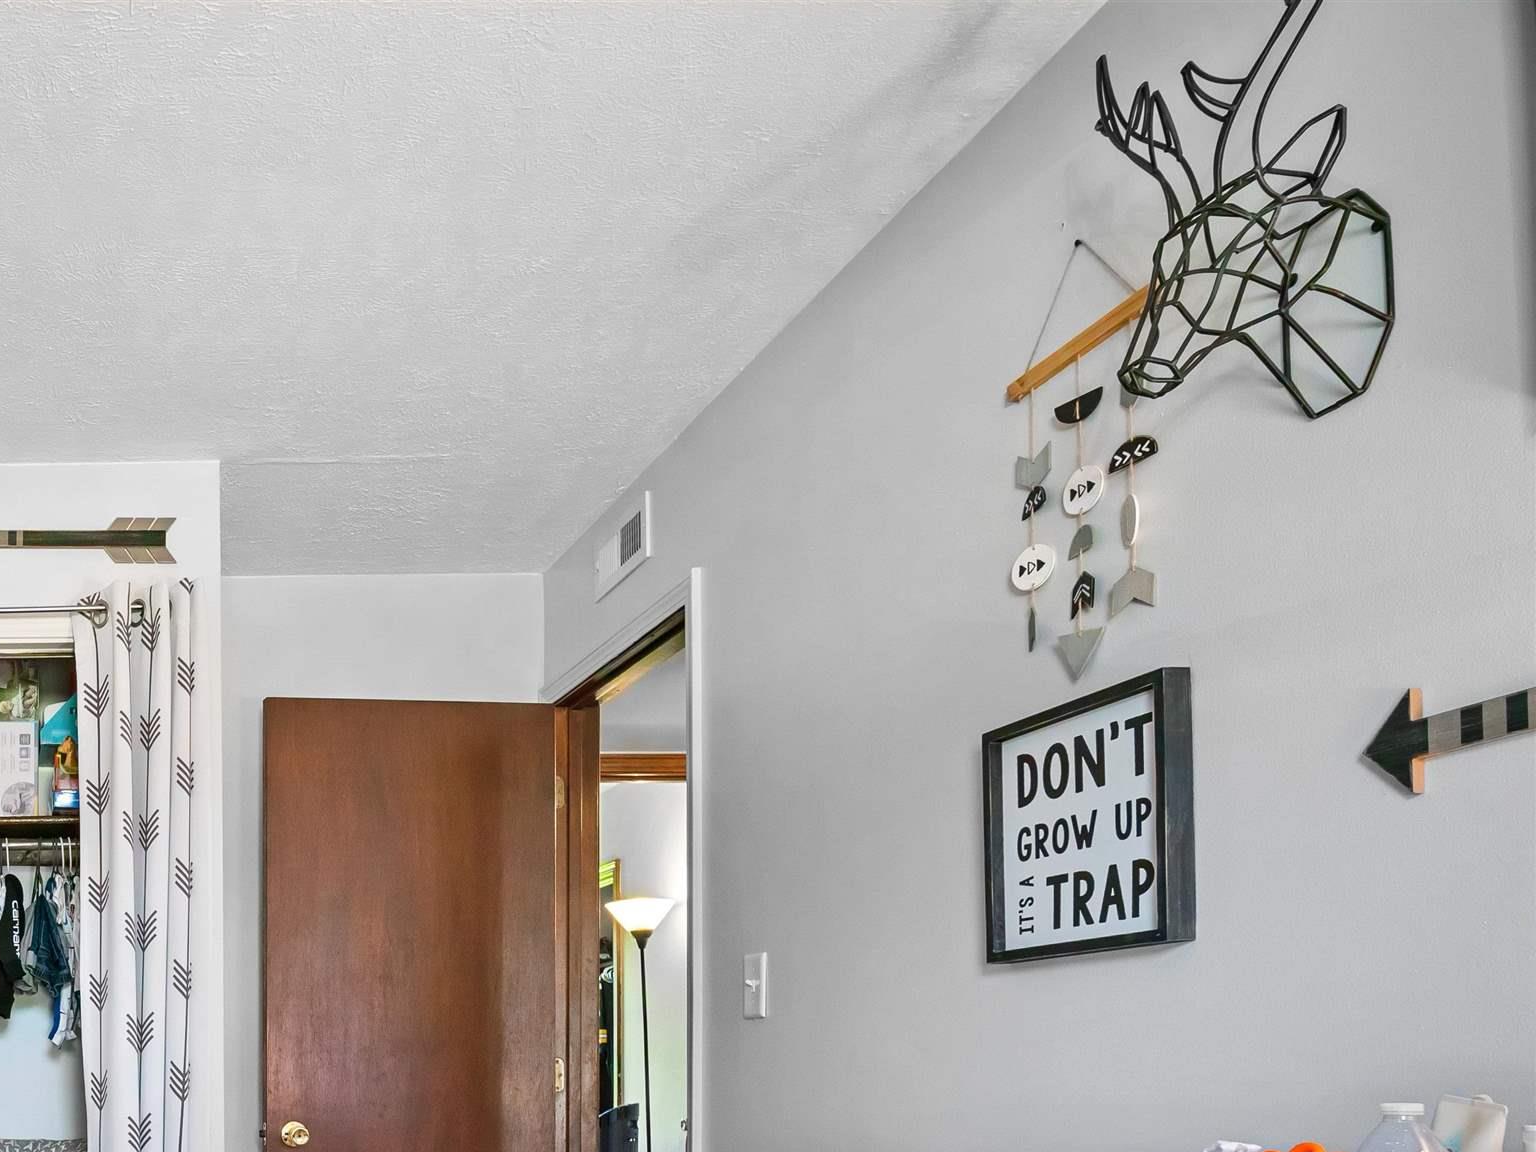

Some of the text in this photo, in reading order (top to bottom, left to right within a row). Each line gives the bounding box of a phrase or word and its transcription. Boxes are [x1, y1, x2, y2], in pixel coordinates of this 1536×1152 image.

[1017, 712, 1153, 809] DON'T
[1017, 797, 1152, 862] GROW UP
[1019, 875, 1035, 935] IT'S A
[1046, 858, 1155, 929] TRAP
